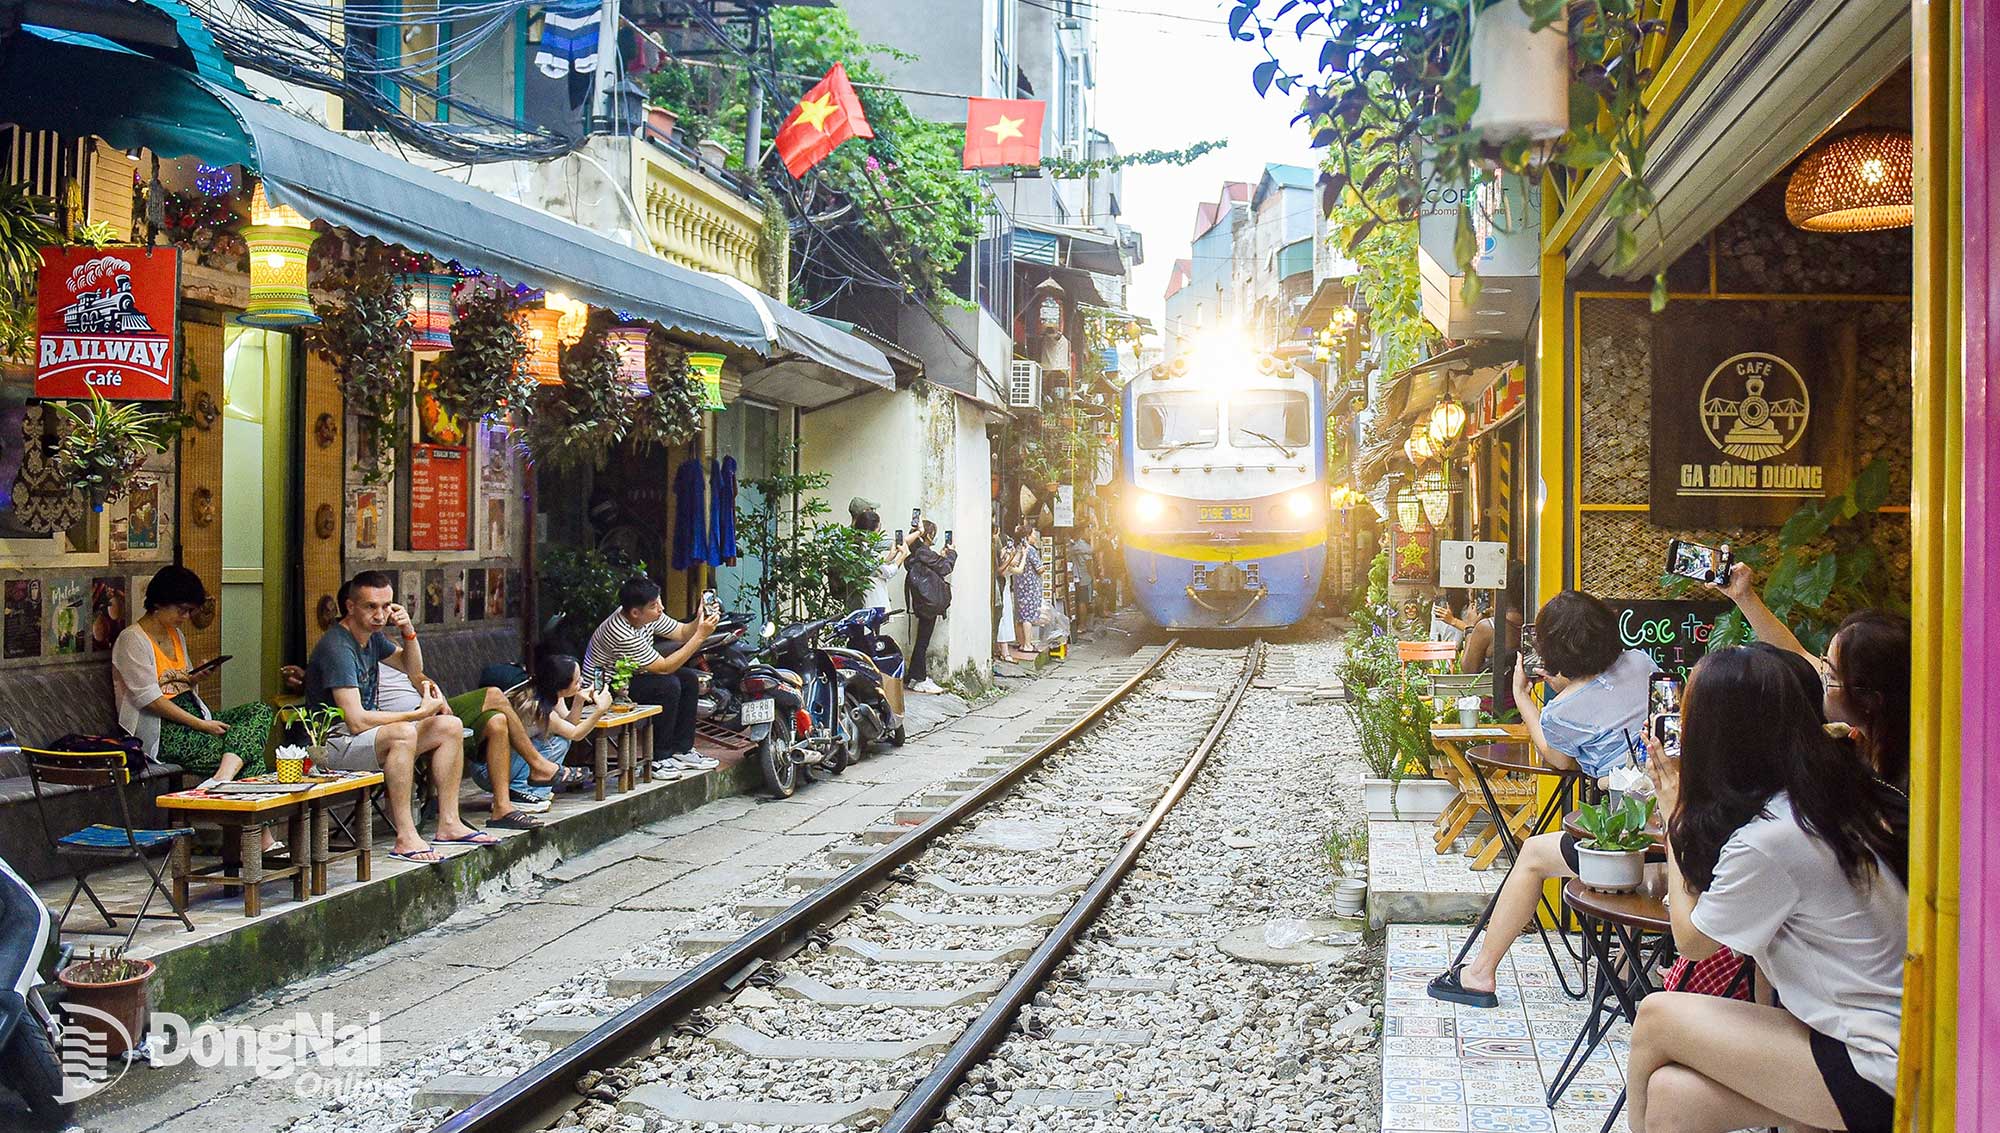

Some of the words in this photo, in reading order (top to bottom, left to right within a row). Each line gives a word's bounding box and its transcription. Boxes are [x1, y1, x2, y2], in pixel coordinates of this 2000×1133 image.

[39, 339, 169, 370] RAILWAY
[85, 370, 122, 386] Café
[1681, 464, 1704, 487] GA
[1708, 461, 1757, 488] ĐÔNG
